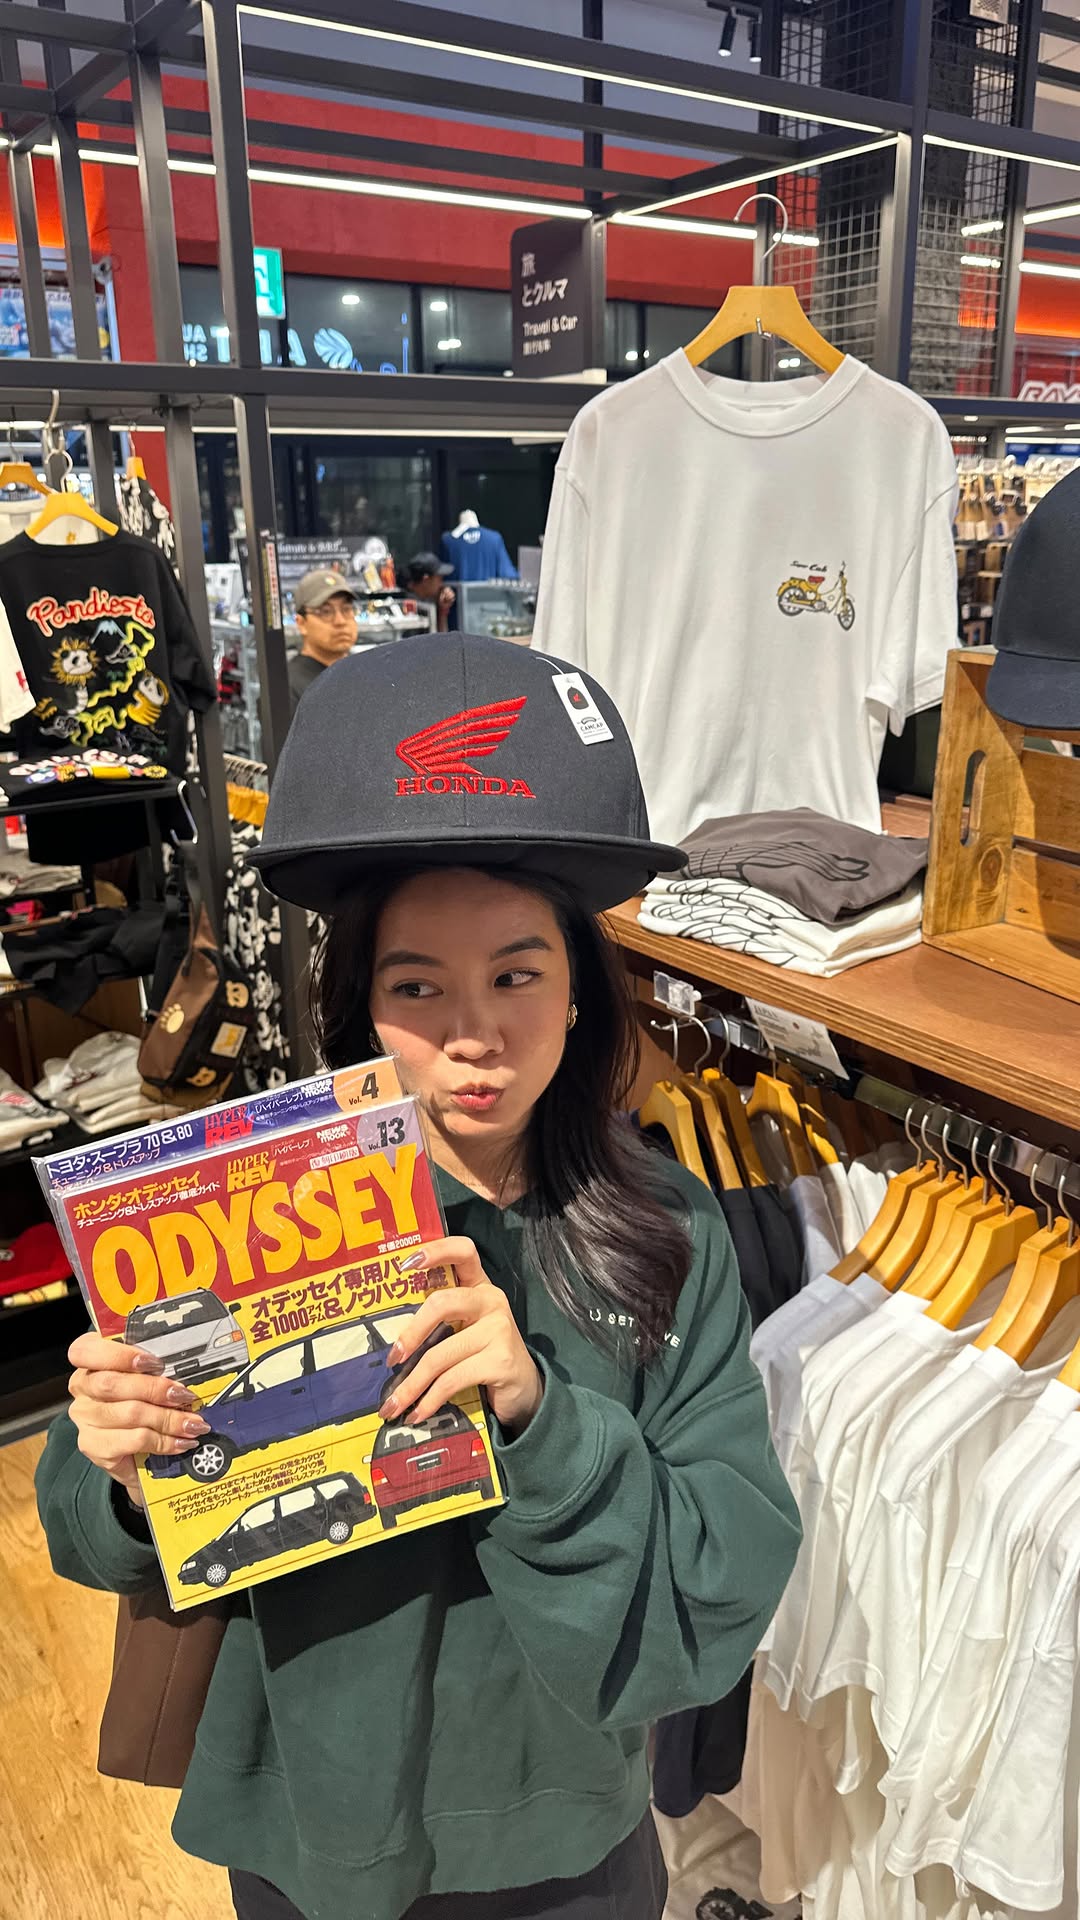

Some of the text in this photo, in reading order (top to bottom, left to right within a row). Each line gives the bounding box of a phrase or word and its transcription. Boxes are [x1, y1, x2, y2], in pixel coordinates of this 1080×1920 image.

[522, 278, 569, 307] とクルマ
[522, 315, 578, 337] Travel & Car
[27, 586, 156, 637] Pandiesta
[580, 722, 603, 731] CAMCAP
[394, 775, 536, 799] HONDA
[300, 1078, 333, 1093] NEWS
[349, 1072, 379, 1106] Vol. 4
[205, 1104, 247, 1129] HYPER
[204, 1114, 255, 1148] REV
[316, 1124, 348, 1139] NEWS
[368, 1116, 405, 1151] Vol. 13
[226, 1159, 277, 1193] REV
[227, 1151, 270, 1175] HYPER
[73, 1170, 201, 1220] ホンダ・オデッセイ
[92, 1142, 419, 1317] ODYSSEY
[608, 1312, 635, 1328] SET
